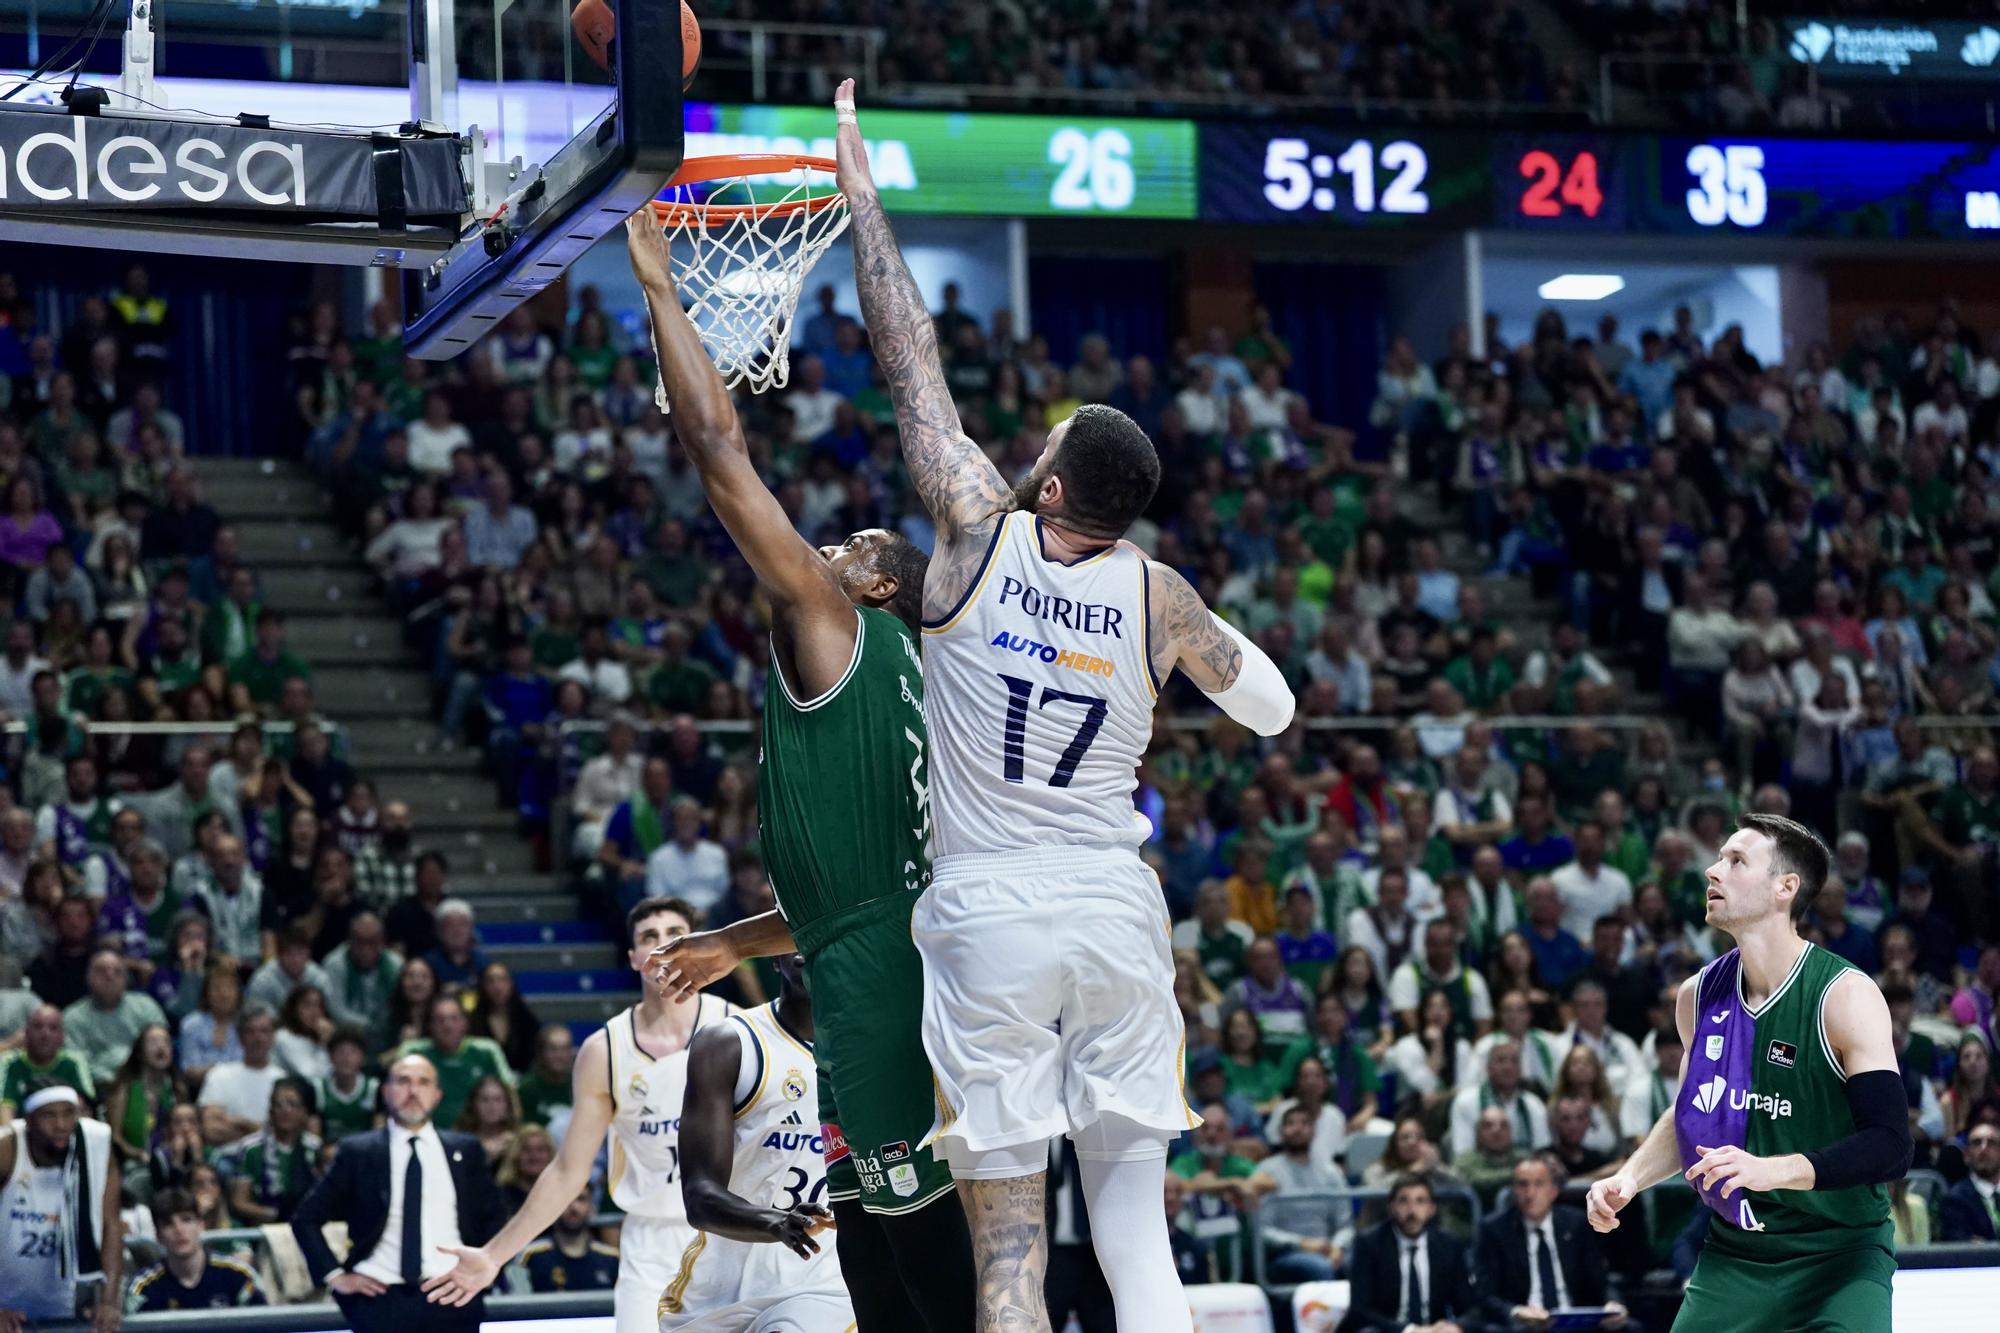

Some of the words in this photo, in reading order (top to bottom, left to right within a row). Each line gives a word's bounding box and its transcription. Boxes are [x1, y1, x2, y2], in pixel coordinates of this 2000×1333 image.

[0, 115, 307, 207] desa
[1048, 127, 1135, 210] 26
[1263, 139, 1429, 213] 5:12
[1520, 150, 1602, 218] 24
[1686, 144, 1766, 226] 35
[998, 575, 1122, 639] POIRIER
[991, 631, 1114, 678] AUTOHERO
[996, 672, 1108, 788] 17
[884, 1149, 903, 1161] acb
[17, 1230, 57, 1258] 28
